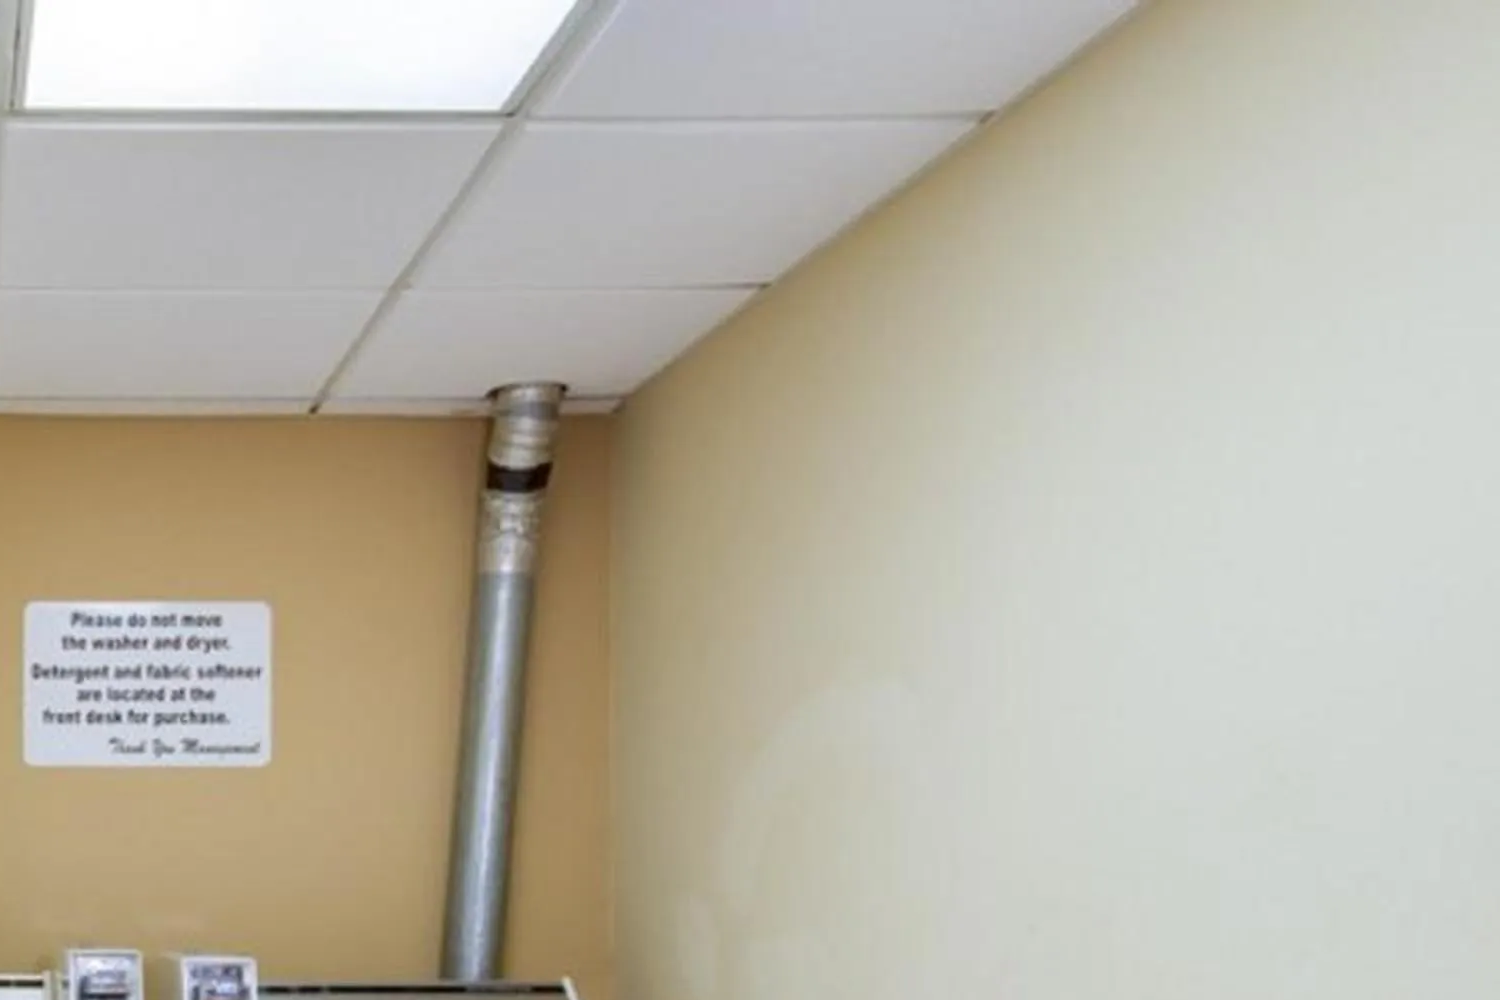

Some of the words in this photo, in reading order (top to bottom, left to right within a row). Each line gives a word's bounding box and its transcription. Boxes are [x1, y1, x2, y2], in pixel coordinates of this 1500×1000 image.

[71, 612, 122, 628] Please
[127, 613, 147, 628] do
[151, 613, 177, 628] not
[180, 614, 222, 628] move
[62, 636, 87, 651] the
[91, 636, 148, 651] washer
[153, 636, 182, 651] and
[186, 636, 232, 653] dryer.
[32, 663, 110, 683] Detergent
[114, 664, 143, 679] and
[147, 663, 190, 679] fabric
[197, 663, 261, 680] softener
[77, 688, 102, 702] are
[107, 687, 165, 702] located
[170, 687, 186, 702] at
[189, 687, 216, 702] the
[42, 710, 81, 725] front
[86, 710, 122, 724] desk
[127, 710, 150, 725] for
[154, 710, 230, 727] purchase.
